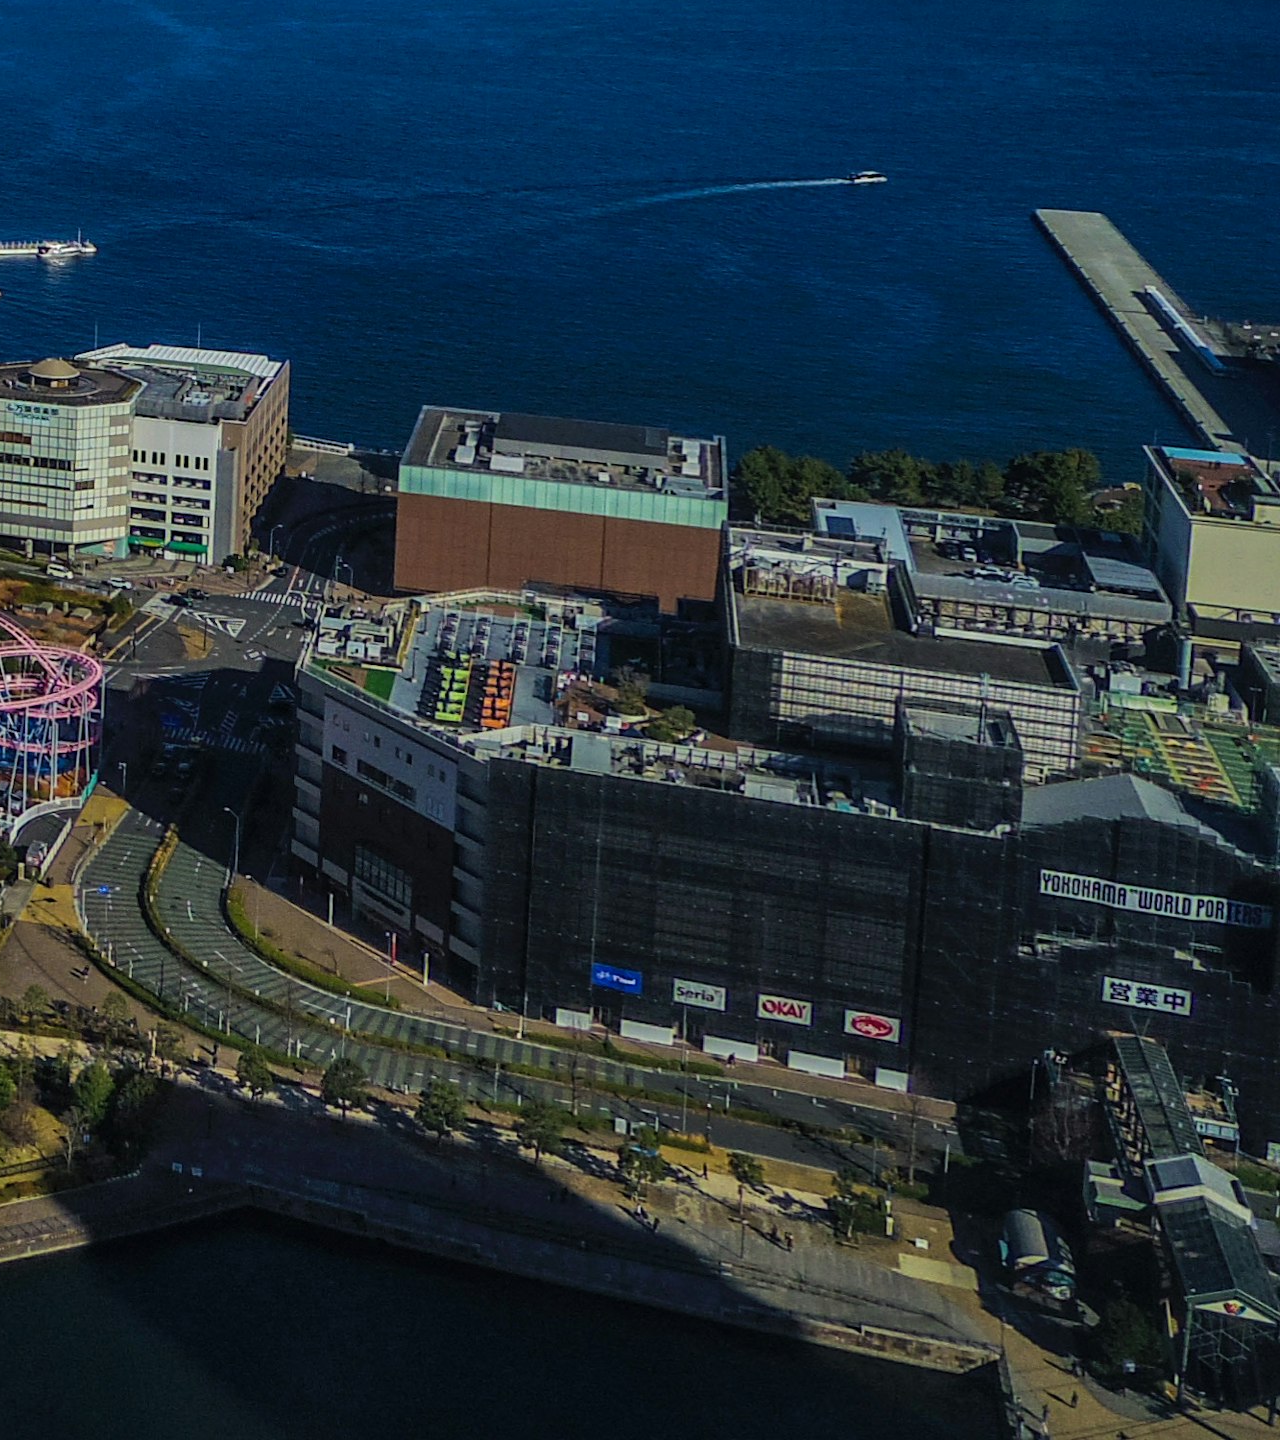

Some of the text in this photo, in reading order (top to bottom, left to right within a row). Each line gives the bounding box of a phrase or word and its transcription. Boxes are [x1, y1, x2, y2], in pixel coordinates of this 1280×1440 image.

[1042, 872, 1128, 907] YOKOHAMA
[676, 985, 715, 1003] Seria
[1109, 982, 1186, 1011] 営業中
[762, 999, 806, 1019] OKAY
